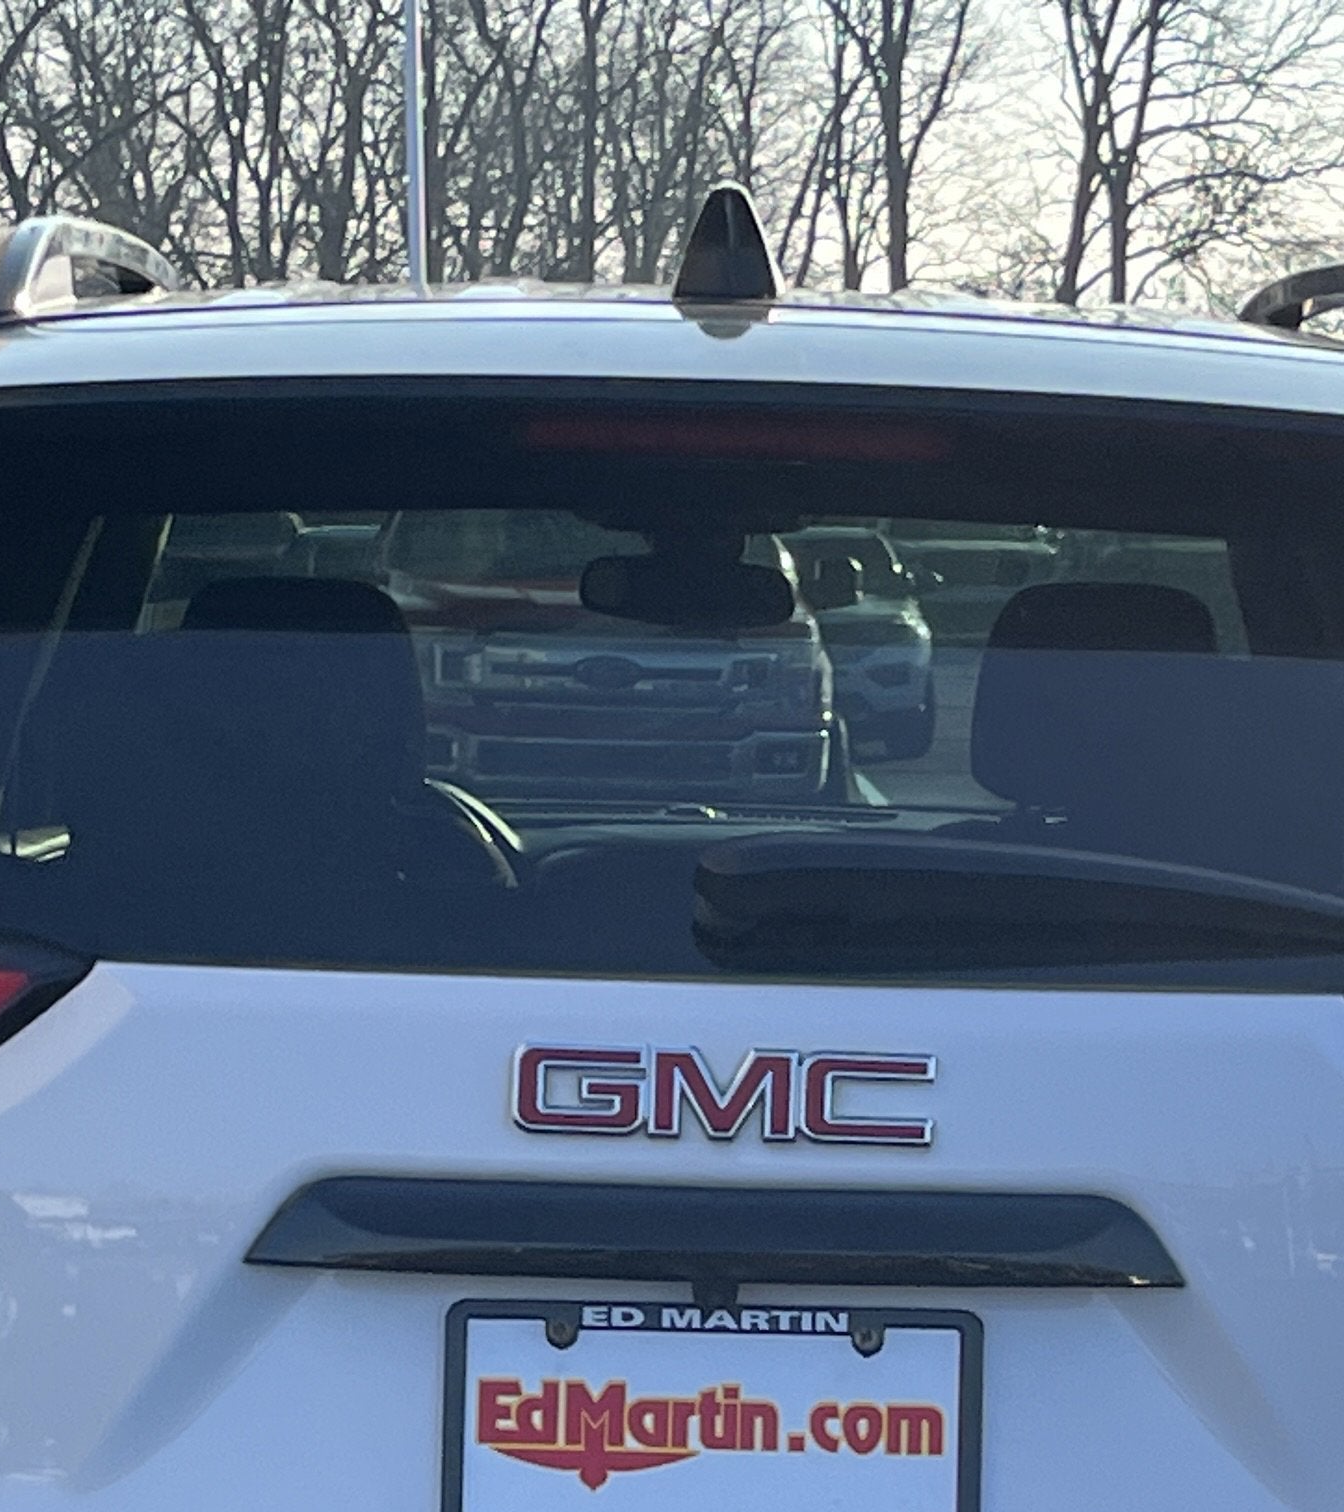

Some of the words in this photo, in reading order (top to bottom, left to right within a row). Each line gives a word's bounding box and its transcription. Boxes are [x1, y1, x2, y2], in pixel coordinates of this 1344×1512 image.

[513, 1042, 937, 1146] GMC
[582, 1306, 645, 1328] ED
[661, 1309, 850, 1333] MARTIN
[476, 1378, 945, 1457] EdMartin.com
